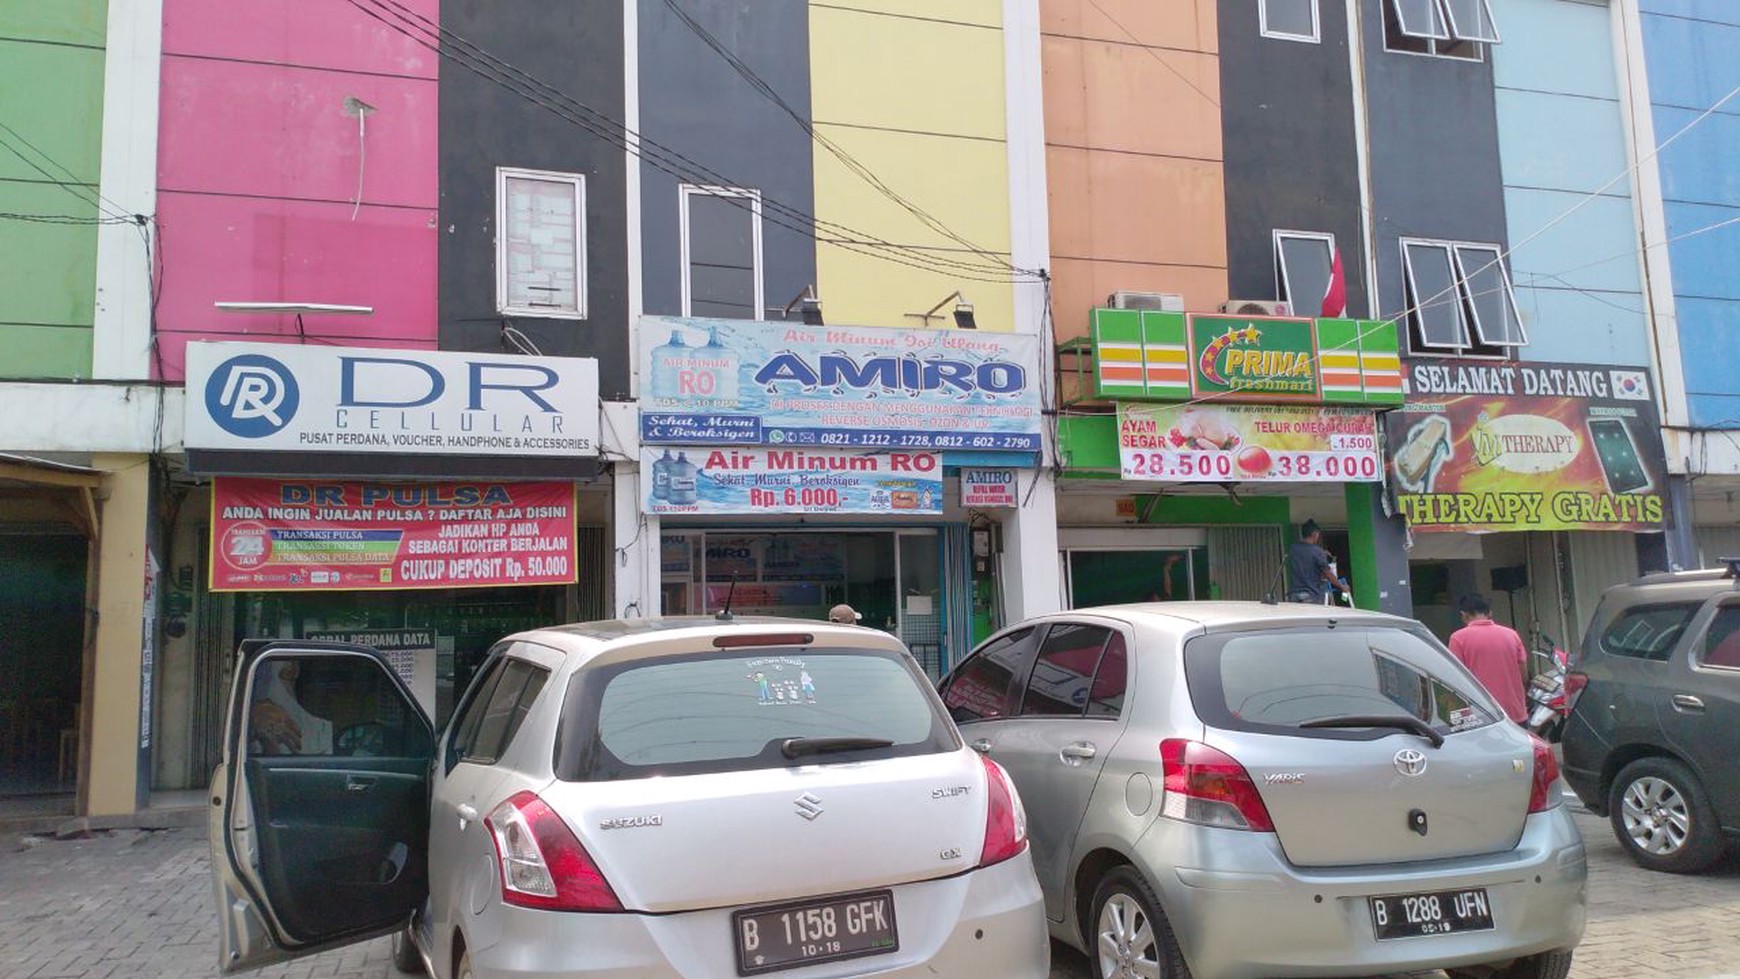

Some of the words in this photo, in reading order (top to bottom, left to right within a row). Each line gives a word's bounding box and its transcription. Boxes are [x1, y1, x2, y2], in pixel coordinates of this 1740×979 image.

[784, 329, 816, 343] Air
[687, 359, 730, 369] MINUM
[1225, 348, 1313, 379] PRIMA
[753, 350, 1027, 396] AMIRO
[1414, 365, 1515, 394] SELAMAT
[1521, 368, 1608, 397] DATANG
[336, 355, 564, 413] DR
[679, 370, 714, 395] RO
[832, 402, 879, 412] DENGAN
[883, 404, 971, 415] MENGGUNAKAN
[336, 409, 563, 434] CELLULAR
[648, 415, 698, 427] Sehat,
[702, 417, 755, 428] Murni
[821, 416, 868, 427] REVERSE
[1122, 420, 1156, 433] AYAM
[1255, 421, 1290, 433] TELUR
[300, 432, 334, 445] PUSAT
[336, 433, 390, 446] PERDANA,
[392, 435, 445, 448] VOUCHER,
[448, 436, 511, 448] HANDPHONE
[514, 437, 520, 447] &
[523, 437, 590, 450] ACCESSORIES
[649, 429, 663, 438] &
[667, 427, 755, 439] Beroksigen
[820, 433, 850, 445] 0821
[861, 434, 890, 446] 1212
[935, 436, 963, 447] 0812
[972, 437, 994, 448] 602
[1003, 438, 1030, 448] 2790
[1122, 435, 1166, 449] SEGAR
[1338, 437, 1372, 449] 1.500
[1502, 434, 1573, 454] THERAPY
[705, 450, 755, 470] Air
[767, 450, 878, 471] Minum
[890, 453, 936, 472] RO
[1132, 453, 1231, 476] 28.500
[1278, 455, 1375, 477] 38.000
[799, 474, 860, 487] Beroksigen
[966, 470, 1012, 484] AMIRO
[281, 484, 347, 507] DR
[361, 484, 514, 507] PULSA
[750, 488, 780, 508] Rp.
[784, 488, 849, 507] 6.000,-
[222, 506, 264, 520] ANDA
[268, 507, 311, 521] INGIN
[315, 508, 372, 522] JUALAN
[377, 508, 423, 521] PULSA
[428, 509, 434, 520] ?
[439, 508, 493, 521] DAFTAR
[496, 508, 522, 520] AJA
[526, 506, 567, 519] DISINI
[1398, 491, 1543, 524] THERAPY
[1552, 490, 1664, 523] GRATIS
[277, 530, 330, 540] TRANSAKSI
[333, 530, 363, 540] PULSA
[439, 523, 489, 538] JADIKAN
[491, 523, 506, 537] HP
[509, 522, 540, 537] ANDA
[408, 539, 459, 554] SEBAGAI
[461, 538, 508, 553] KONTER
[511, 536, 567, 552] BERJALAN
[238, 556, 257, 565] JAM
[400, 560, 446, 581] CUKUP
[449, 558, 502, 580] DEPOSIT
[505, 558, 526, 581] Rp.
[528, 556, 567, 578] 50.000
[350, 633, 400, 647] PERDANA
[403, 633, 431, 646] DATA
[932, 785, 973, 799] SWIFT
[599, 814, 663, 830] SUZUKI
[1375, 900, 1388, 926] B
[1402, 895, 1442, 923] 1288
[1454, 892, 1488, 918] UFN
[743, 918, 760, 951] B
[781, 906, 837, 945] 1158
[846, 900, 888, 935] GFK
